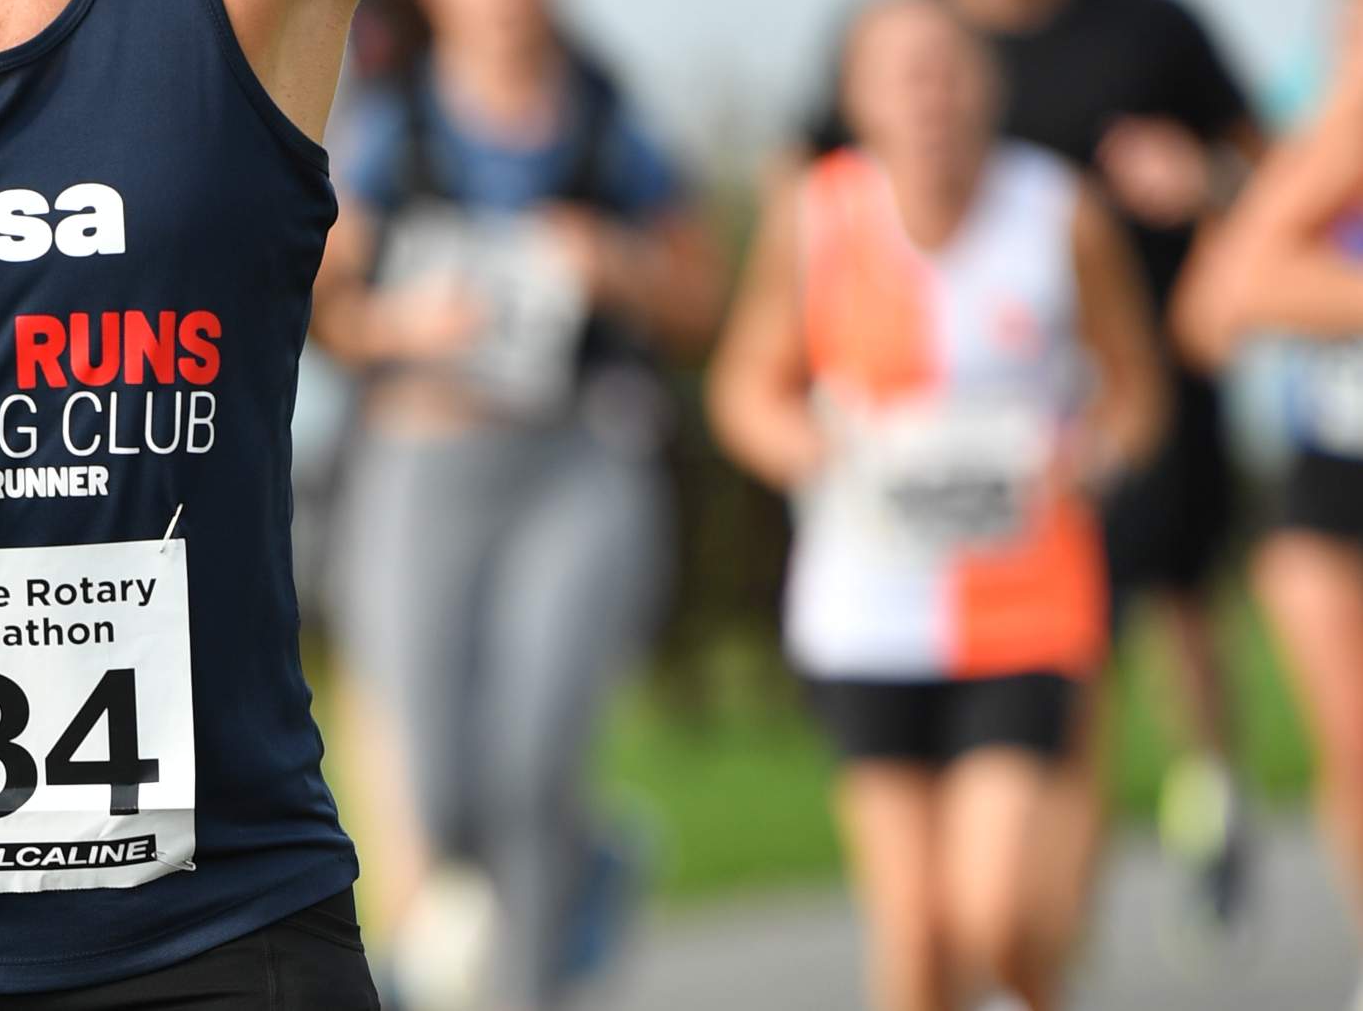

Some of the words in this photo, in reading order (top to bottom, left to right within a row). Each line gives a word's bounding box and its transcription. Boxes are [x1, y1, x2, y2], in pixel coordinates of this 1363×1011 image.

[15, 310, 222, 390] RUNS
[62, 390, 216, 458] CLUB
[26, 576, 157, 607] Rotary
